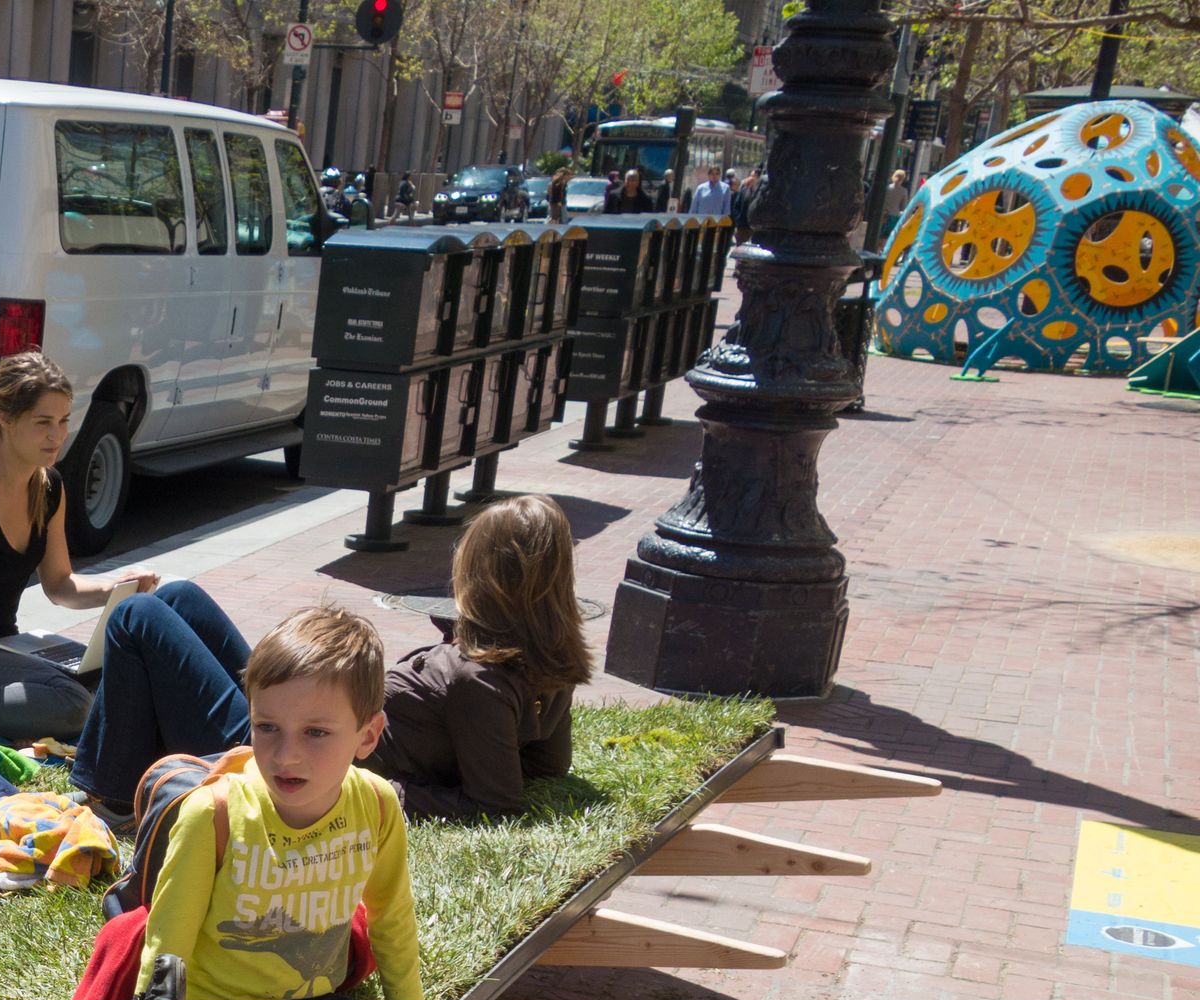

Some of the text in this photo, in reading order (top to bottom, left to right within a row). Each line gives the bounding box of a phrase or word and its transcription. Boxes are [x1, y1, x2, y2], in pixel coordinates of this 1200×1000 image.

[325, 380, 346, 388] JOBS
[354, 382, 392, 390] CAREERS
[323, 395, 388, 407] CommonGround
[316, 433, 341, 442] CONTRA
[342, 435, 363, 443] COSTA
